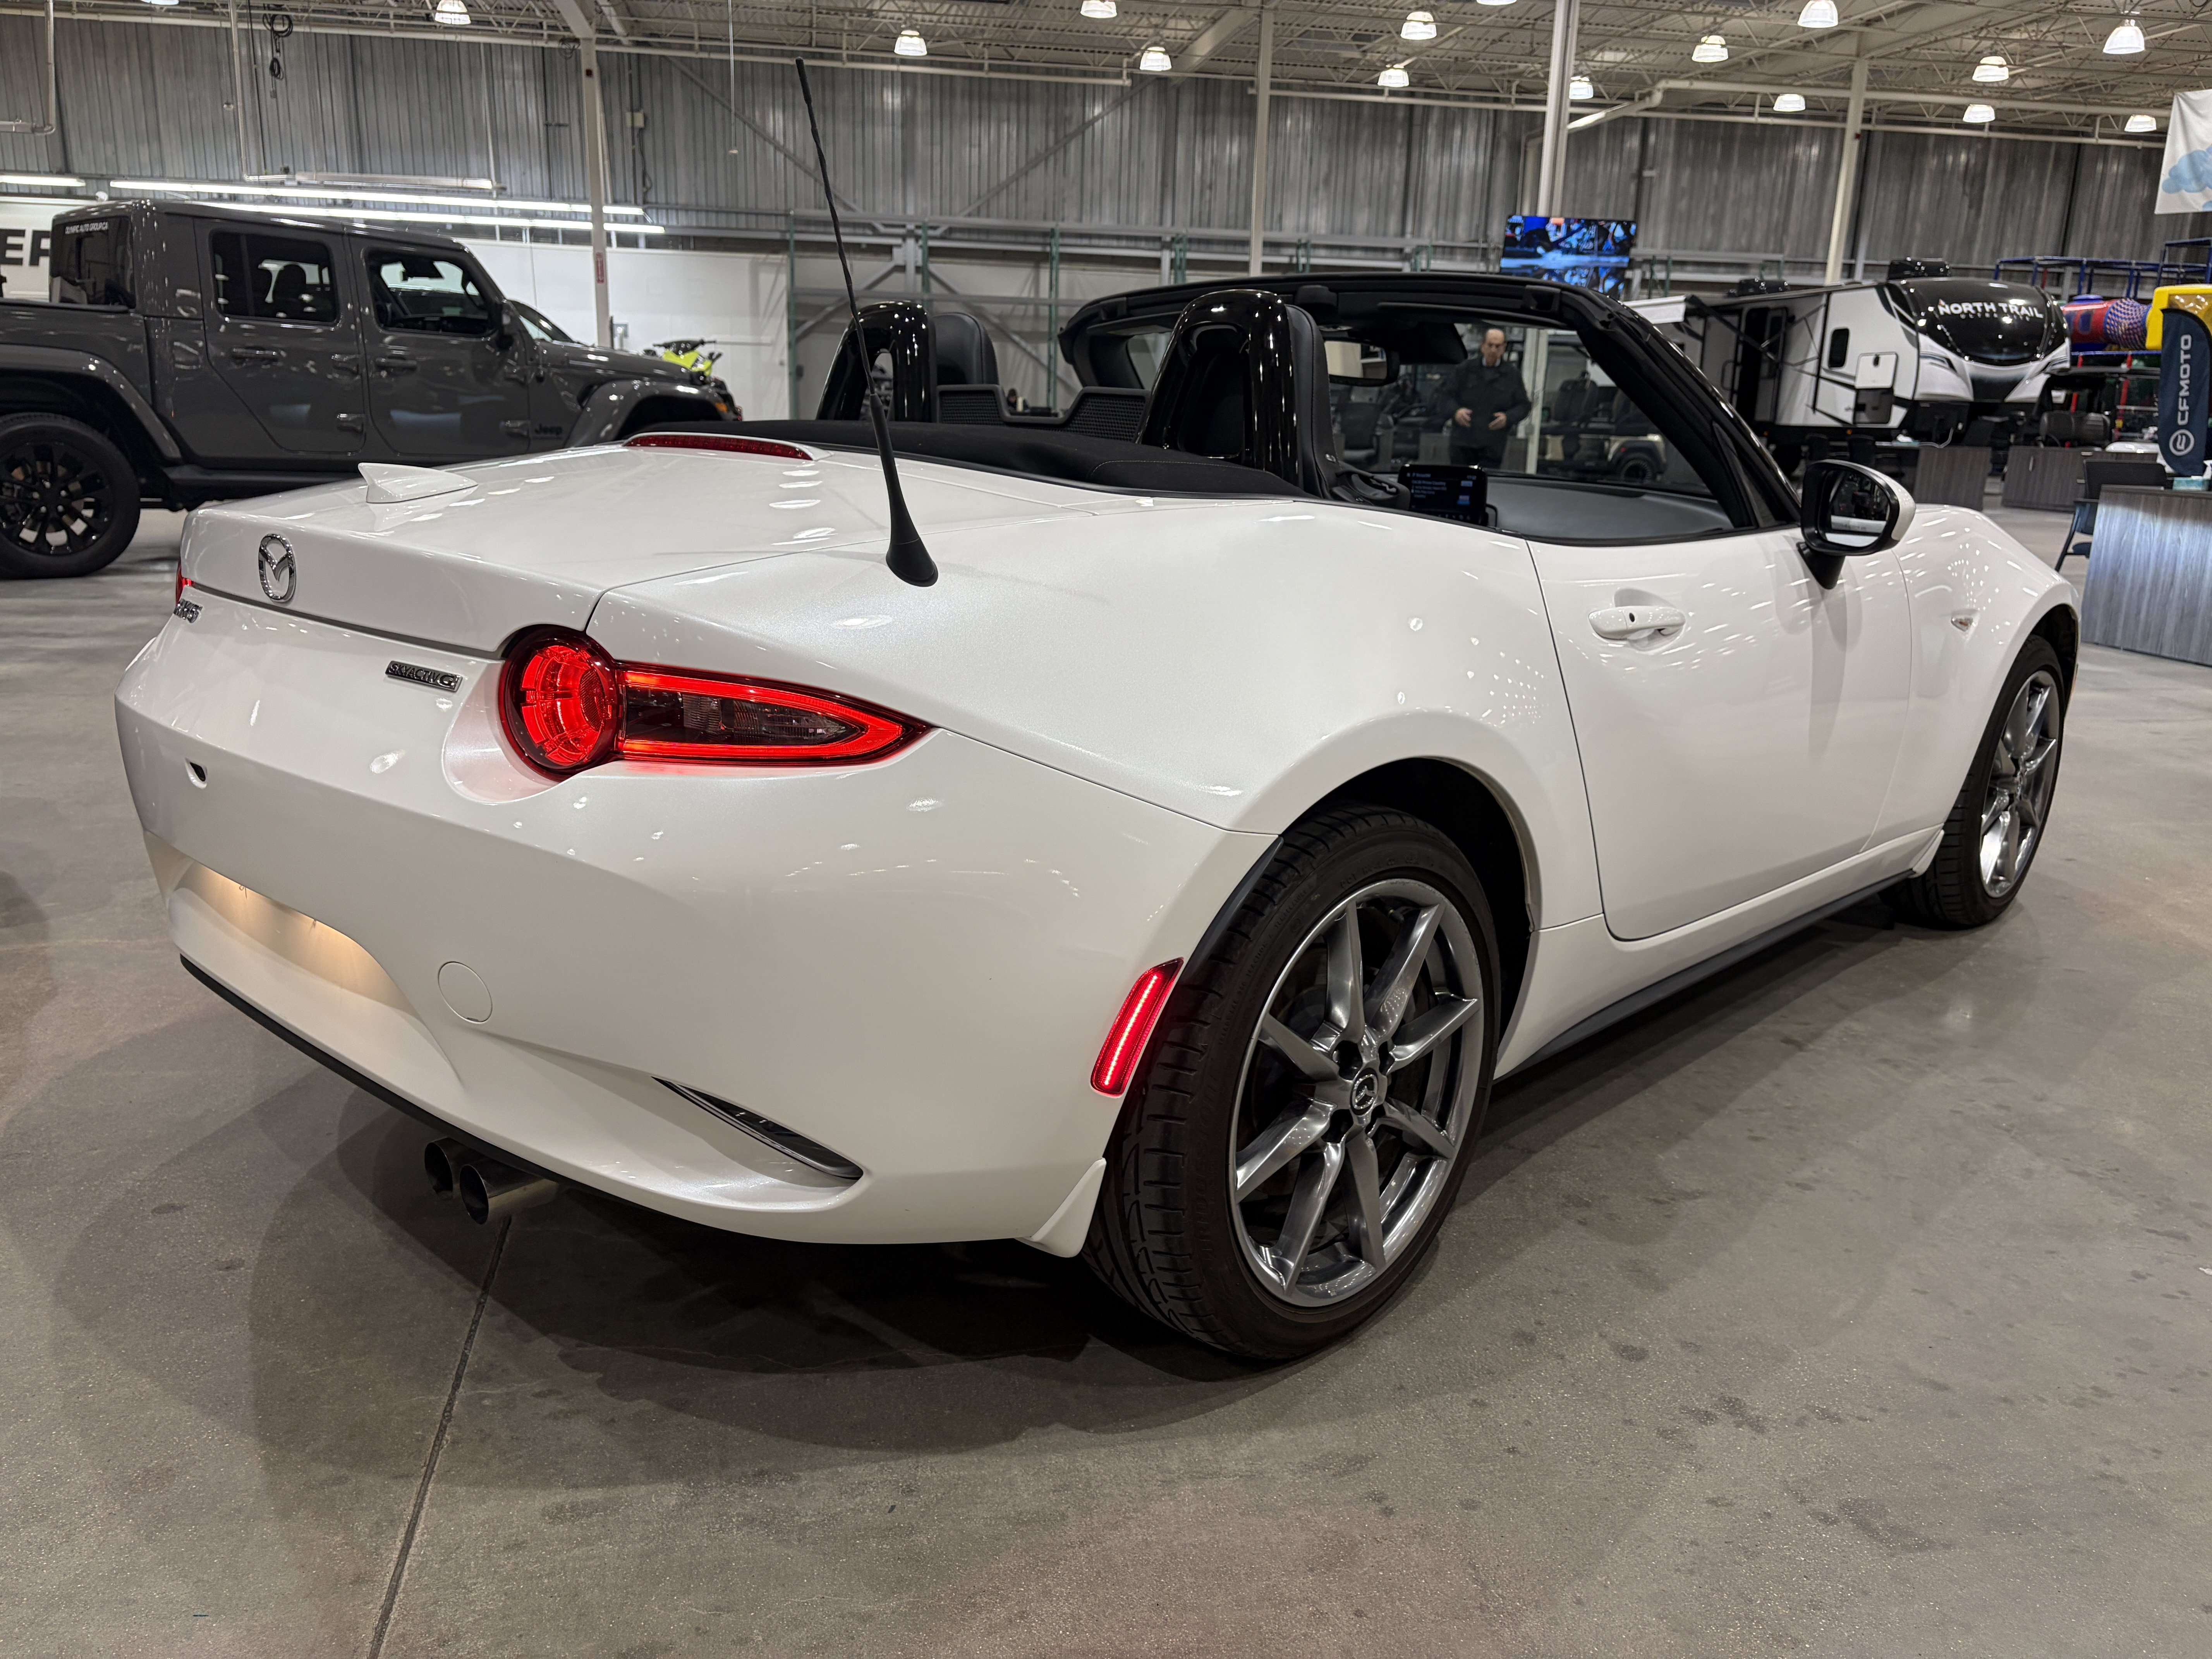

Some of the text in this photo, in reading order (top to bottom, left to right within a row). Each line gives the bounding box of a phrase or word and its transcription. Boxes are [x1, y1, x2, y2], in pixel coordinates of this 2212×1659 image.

[1937, 302, 2044, 319] NORTH TRAIL
[2177, 334, 2192, 426] CFMOTO
[534, 424, 563, 436] Jeep
[388, 663, 440, 684] SKYACTIV
